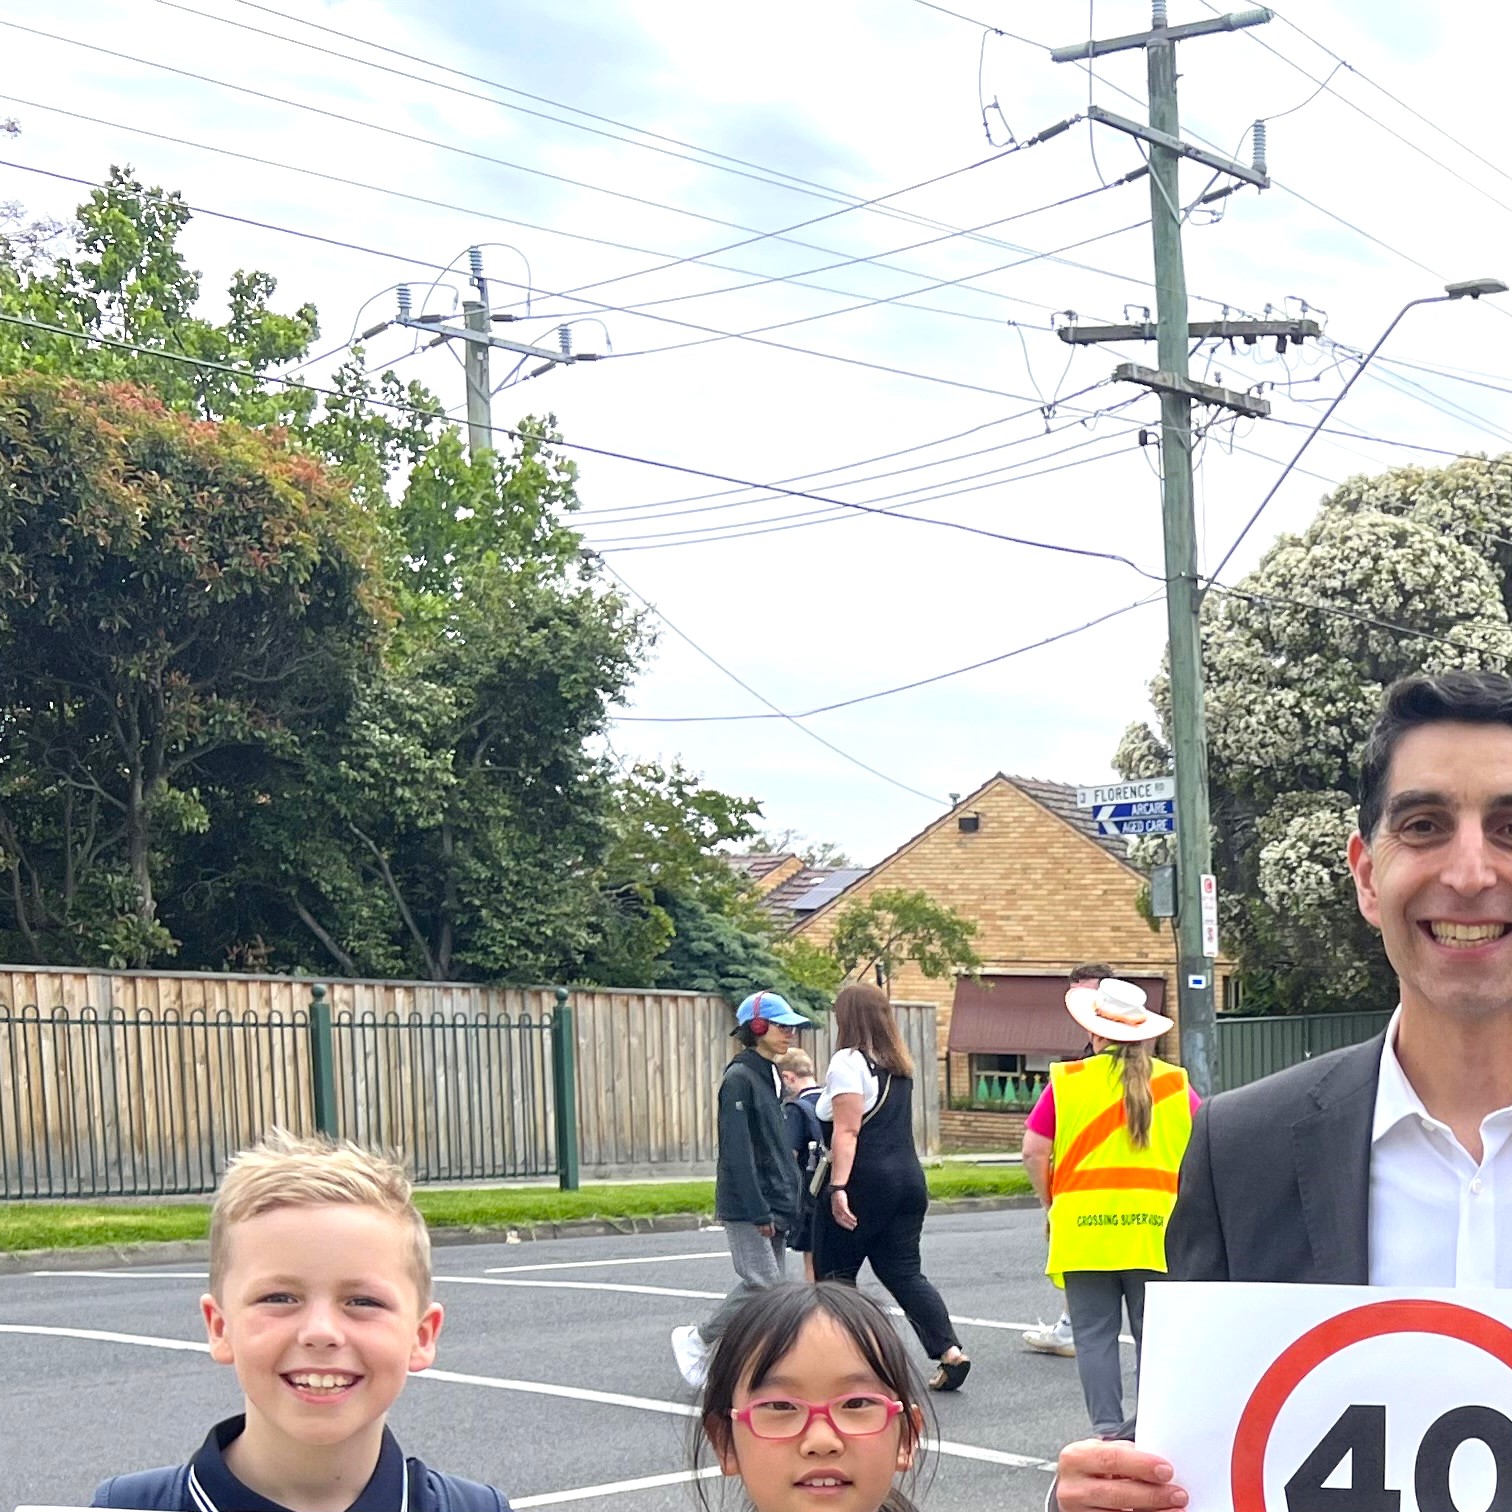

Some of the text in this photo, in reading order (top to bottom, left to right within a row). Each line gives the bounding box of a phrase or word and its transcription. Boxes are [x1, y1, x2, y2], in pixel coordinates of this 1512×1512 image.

[1094, 784, 1152, 803] FLORENCE
[1145, 818, 1168, 832] CARE
[1077, 1214, 1119, 1227] CROSSING
